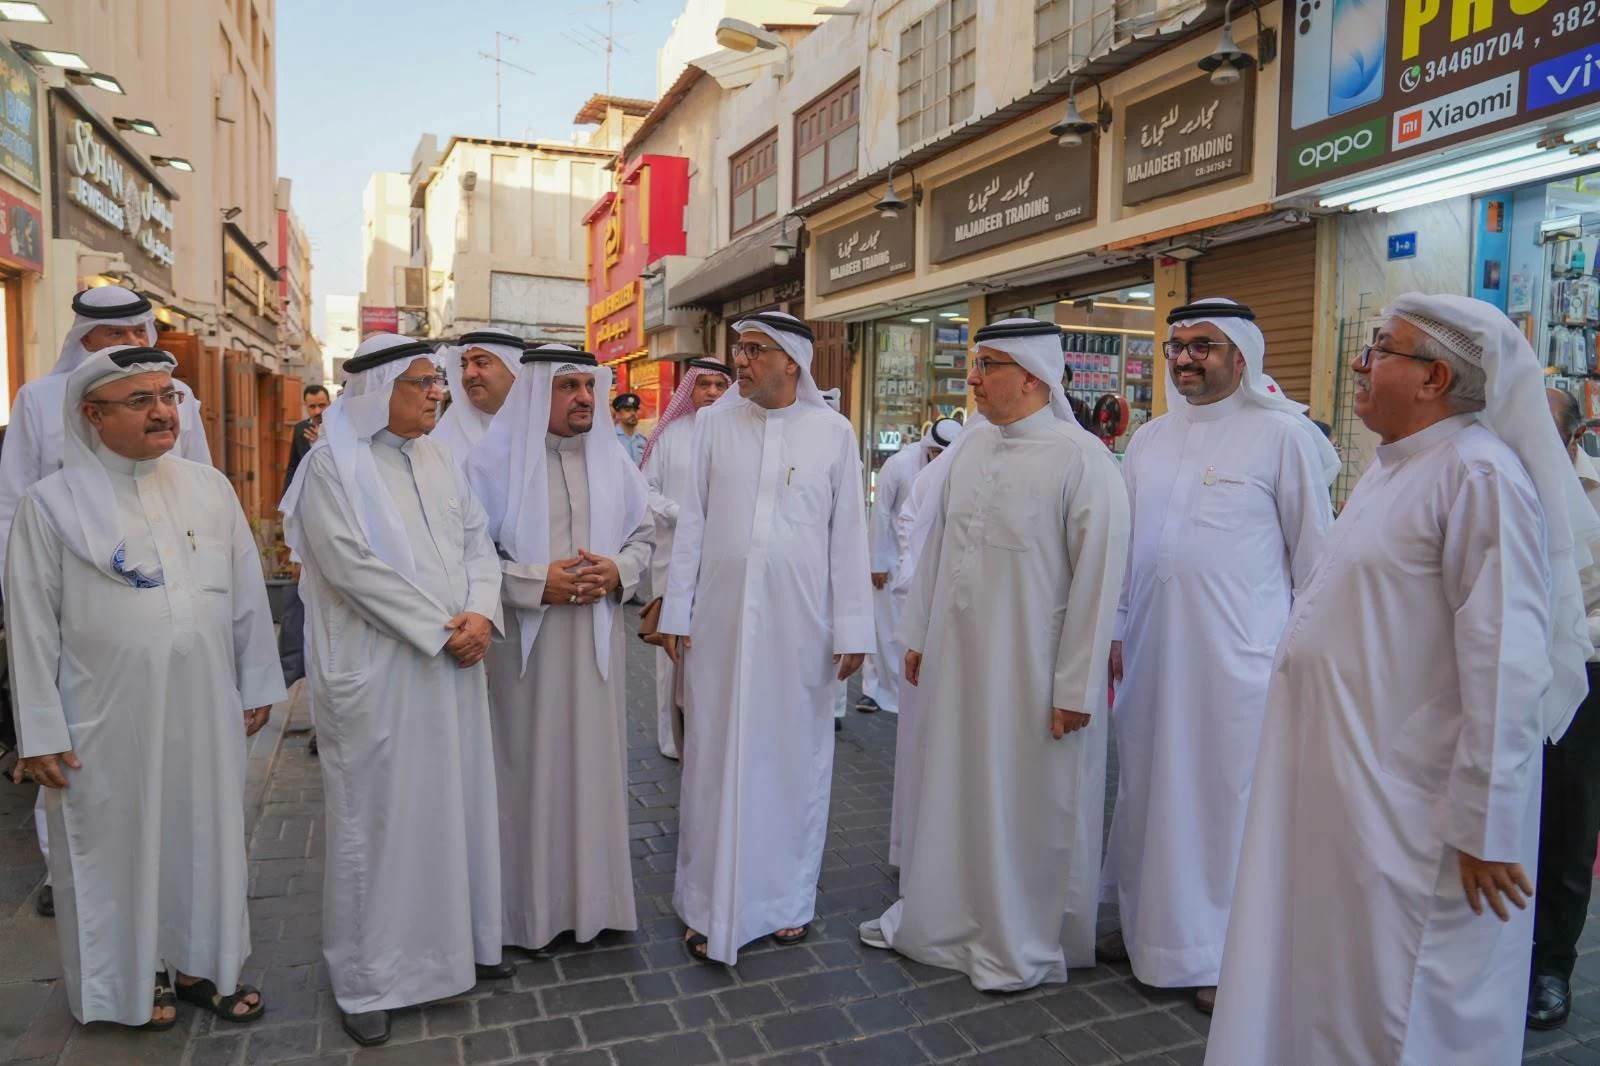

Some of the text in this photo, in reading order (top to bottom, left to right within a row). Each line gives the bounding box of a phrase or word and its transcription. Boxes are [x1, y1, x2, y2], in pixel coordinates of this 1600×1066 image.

[1425, 27, 1524, 83] 34460704
[1551, 0, 1600, 37] 382
[1546, 53, 1600, 95] vi
[1140, 99, 1220, 148] مجادير للتجارة
[1427, 84, 1512, 132] Xiaomi
[1127, 133, 1233, 184] MAJADEER TRADING
[1299, 130, 1373, 168] oppo
[955, 196, 1050, 242] MAJADEER TRADING
